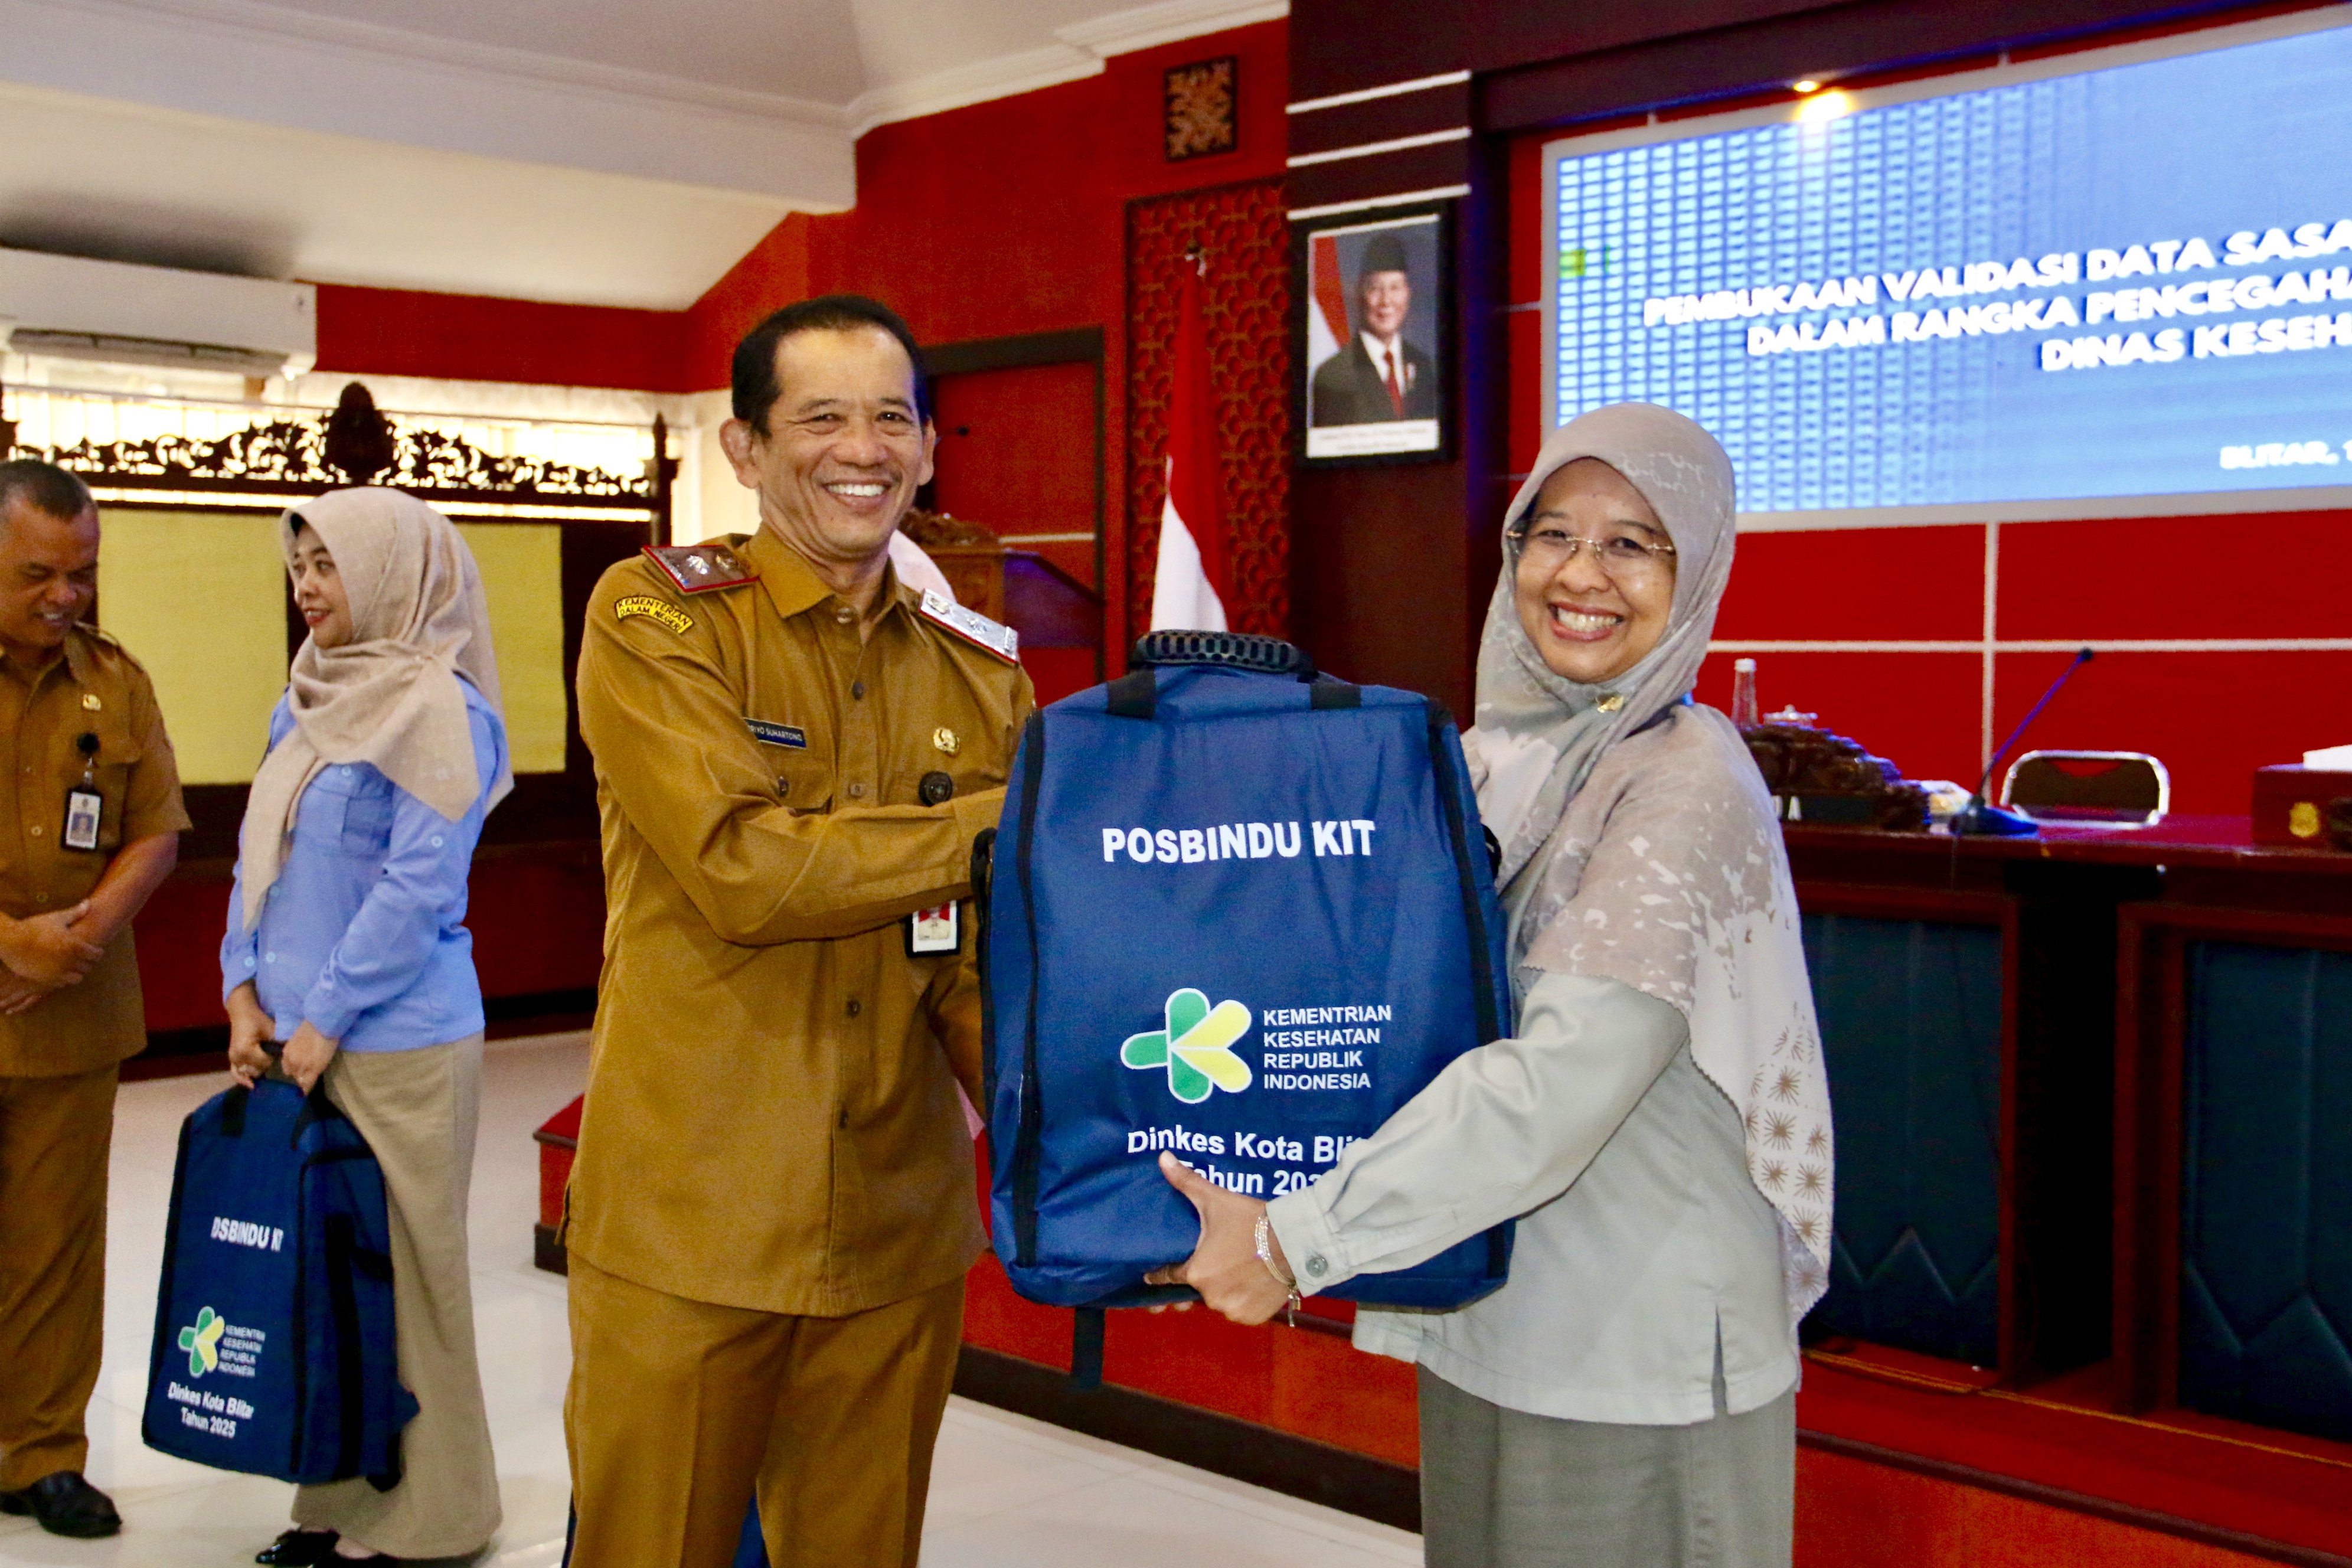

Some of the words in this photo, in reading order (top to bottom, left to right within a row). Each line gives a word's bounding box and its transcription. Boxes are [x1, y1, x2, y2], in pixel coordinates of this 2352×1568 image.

[1644, 275, 1877, 326] PEMBUKAAN
[1881, 252, 2078, 301] VALIDASI
[2086, 238, 2216, 281] DATA
[1747, 315, 1886, 355] DALAM
[1892, 296, 2079, 343] RANGKA
[2086, 266, 2352, 324] PENCEGAH
[2041, 328, 2184, 371] DINAS
[618, 596, 689, 626] KEMENTERIAN
[619, 606, 649, 616] DALAM
[1103, 821, 1301, 863] POSBINDU
[1312, 819, 1375, 857] KIT
[1263, 1005, 1391, 1026] KEMENTRIAN
[1263, 1028, 1380, 1048] KESEHATAN
[1264, 1050, 1363, 1069] REPUBLIK
[1264, 1073, 1371, 1090] INDONESIA
[1128, 1125, 1225, 1155] Dinkes
[1235, 1132, 1303, 1162] Kota
[168, 1381, 201, 1406] Dinkes
[202, 1391, 225, 1413] Kota
[226, 1397, 254, 1419] Blitar
[181, 1406, 208, 1432] Tahun
[210, 1415, 236, 1439] 2025
